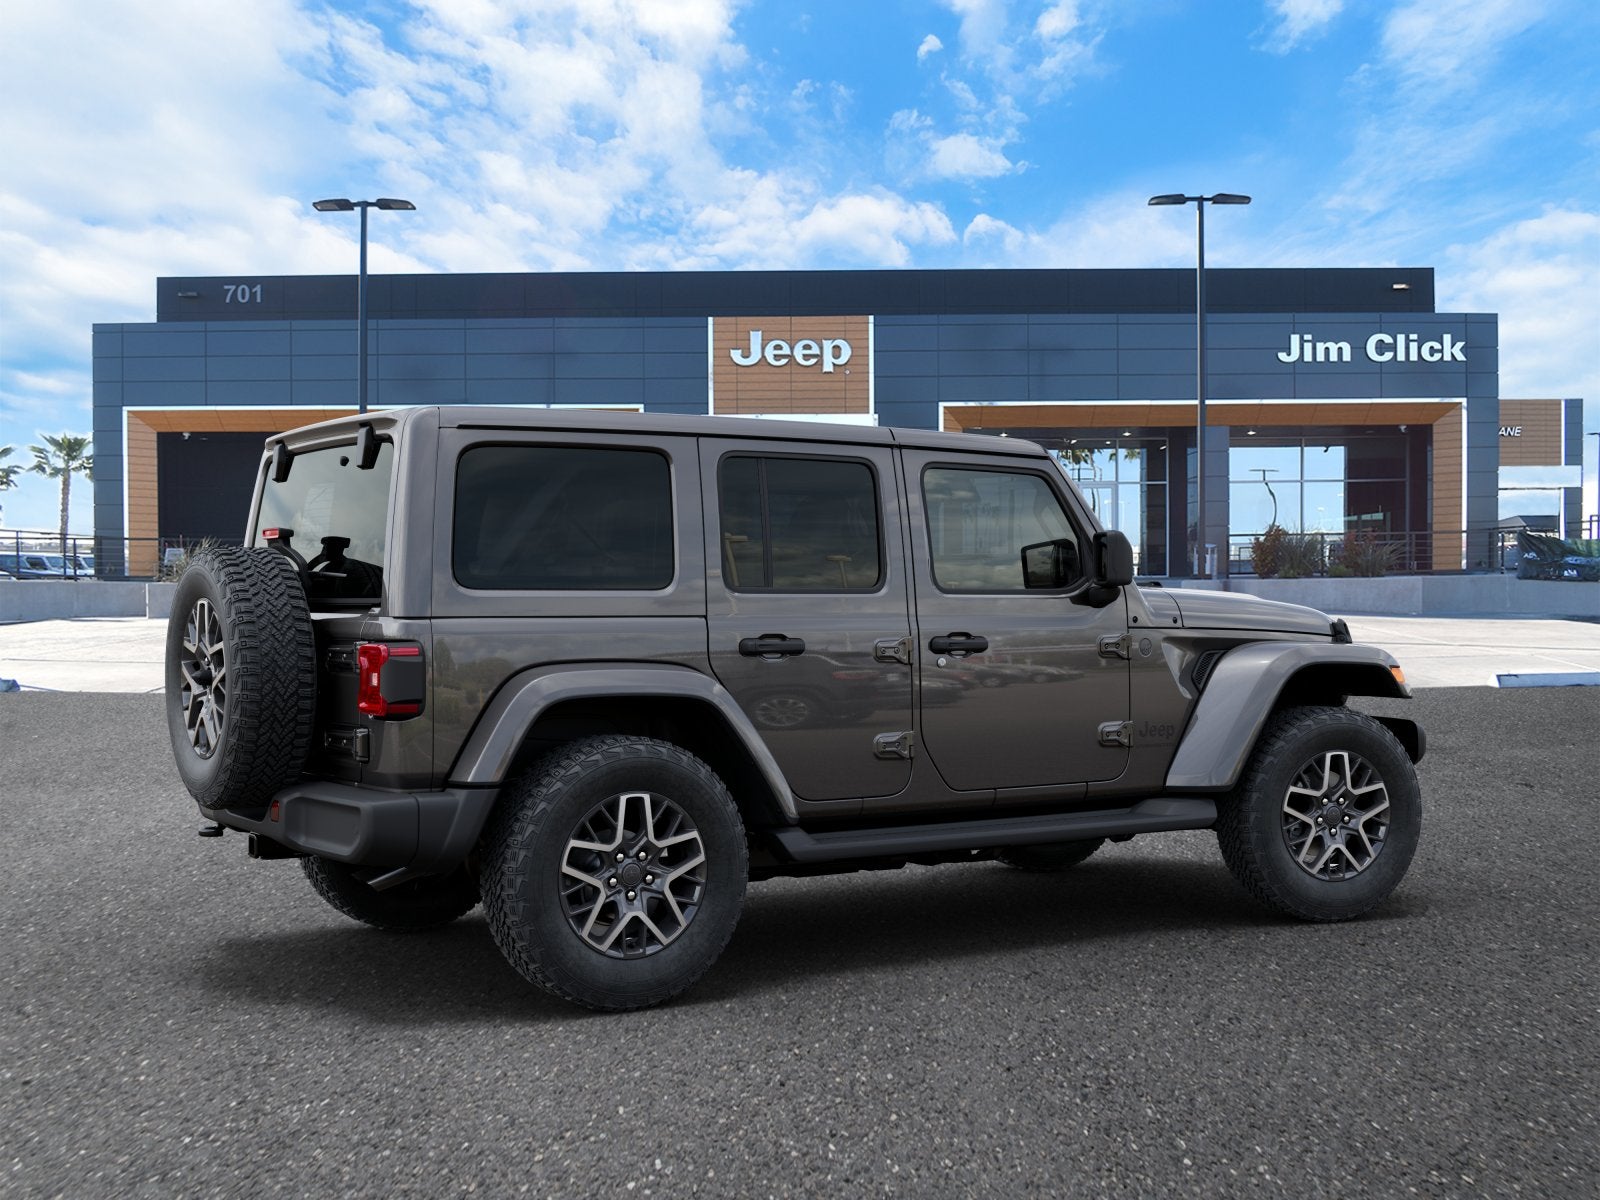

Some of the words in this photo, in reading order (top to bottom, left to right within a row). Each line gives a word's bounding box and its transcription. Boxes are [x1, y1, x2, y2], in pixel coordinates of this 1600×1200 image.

[223, 284, 262, 303] 701
[729, 330, 852, 374] Jeep
[1277, 333, 1352, 363] Jim
[1366, 333, 1467, 362] Click
[1138, 720, 1175, 740] Jeep
